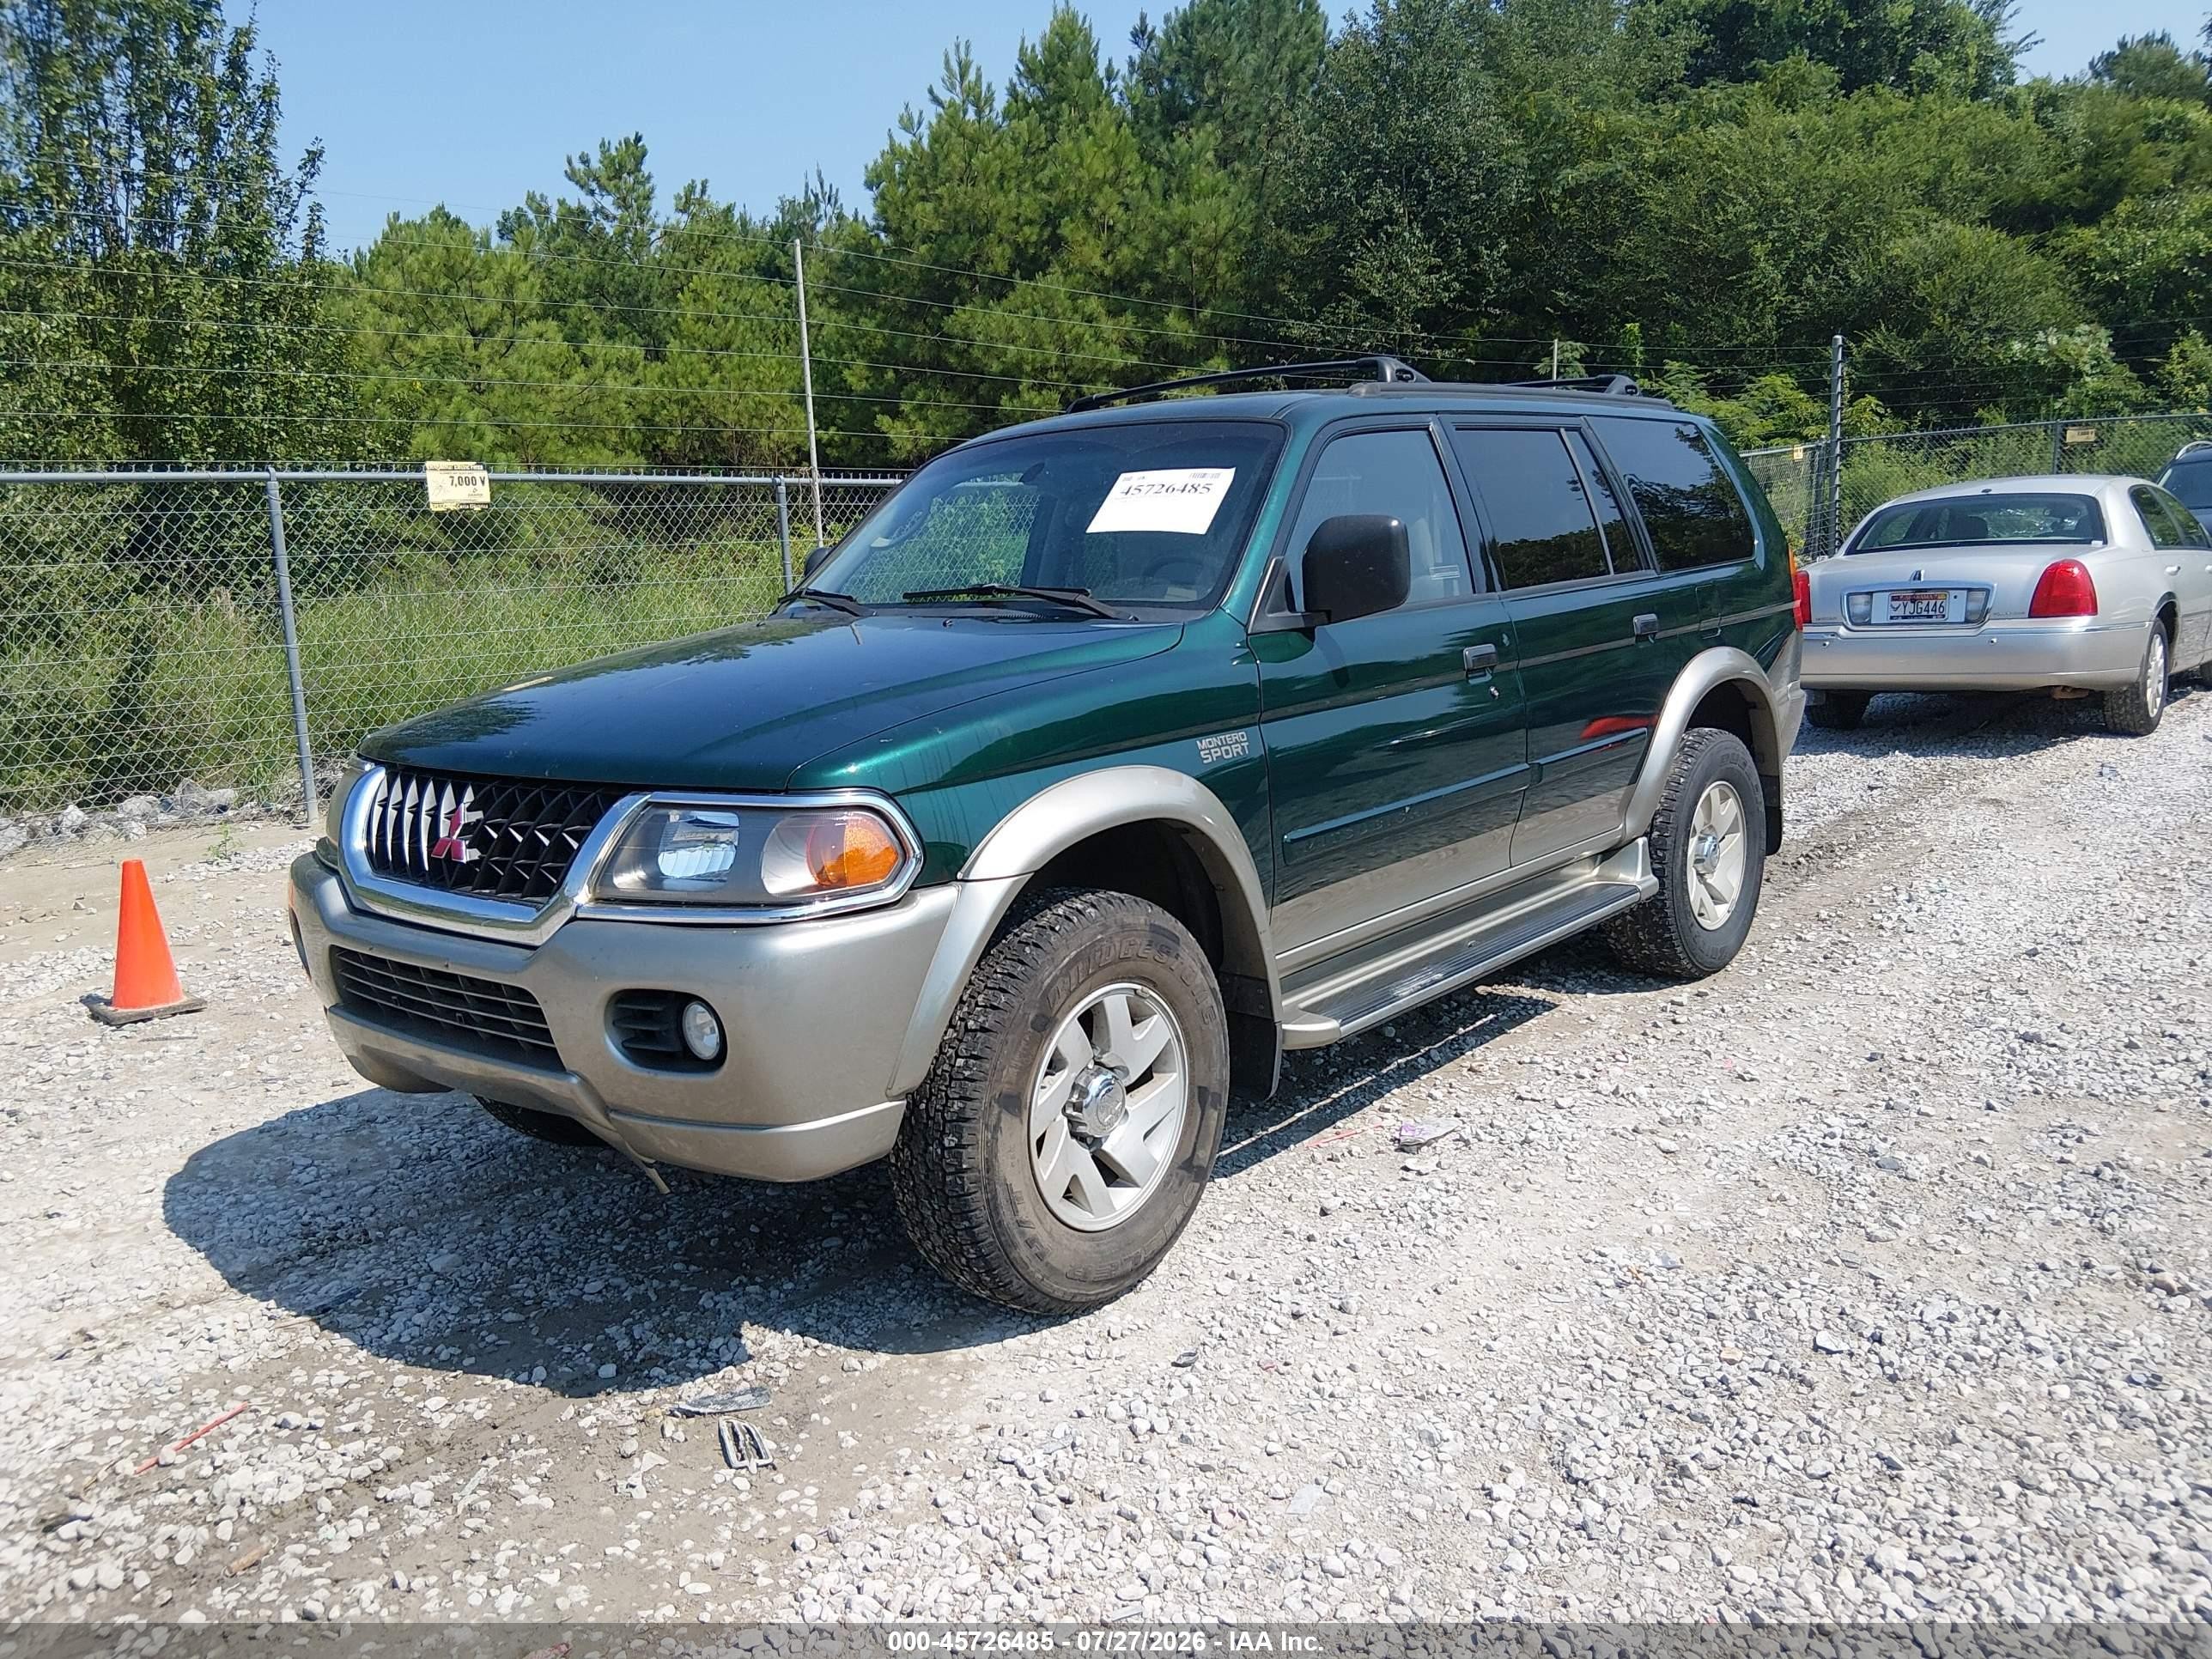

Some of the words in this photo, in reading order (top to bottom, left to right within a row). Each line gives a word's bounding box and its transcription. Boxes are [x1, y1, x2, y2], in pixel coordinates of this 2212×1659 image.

[449, 476, 477, 487] 7,000
[479, 476, 485, 486] V
[1120, 483, 1213, 495] 45726485
[1902, 600, 1945, 615] YJG446
[1196, 732, 1247, 750] MONTERO
[1200, 742, 1249, 763] SPORT
